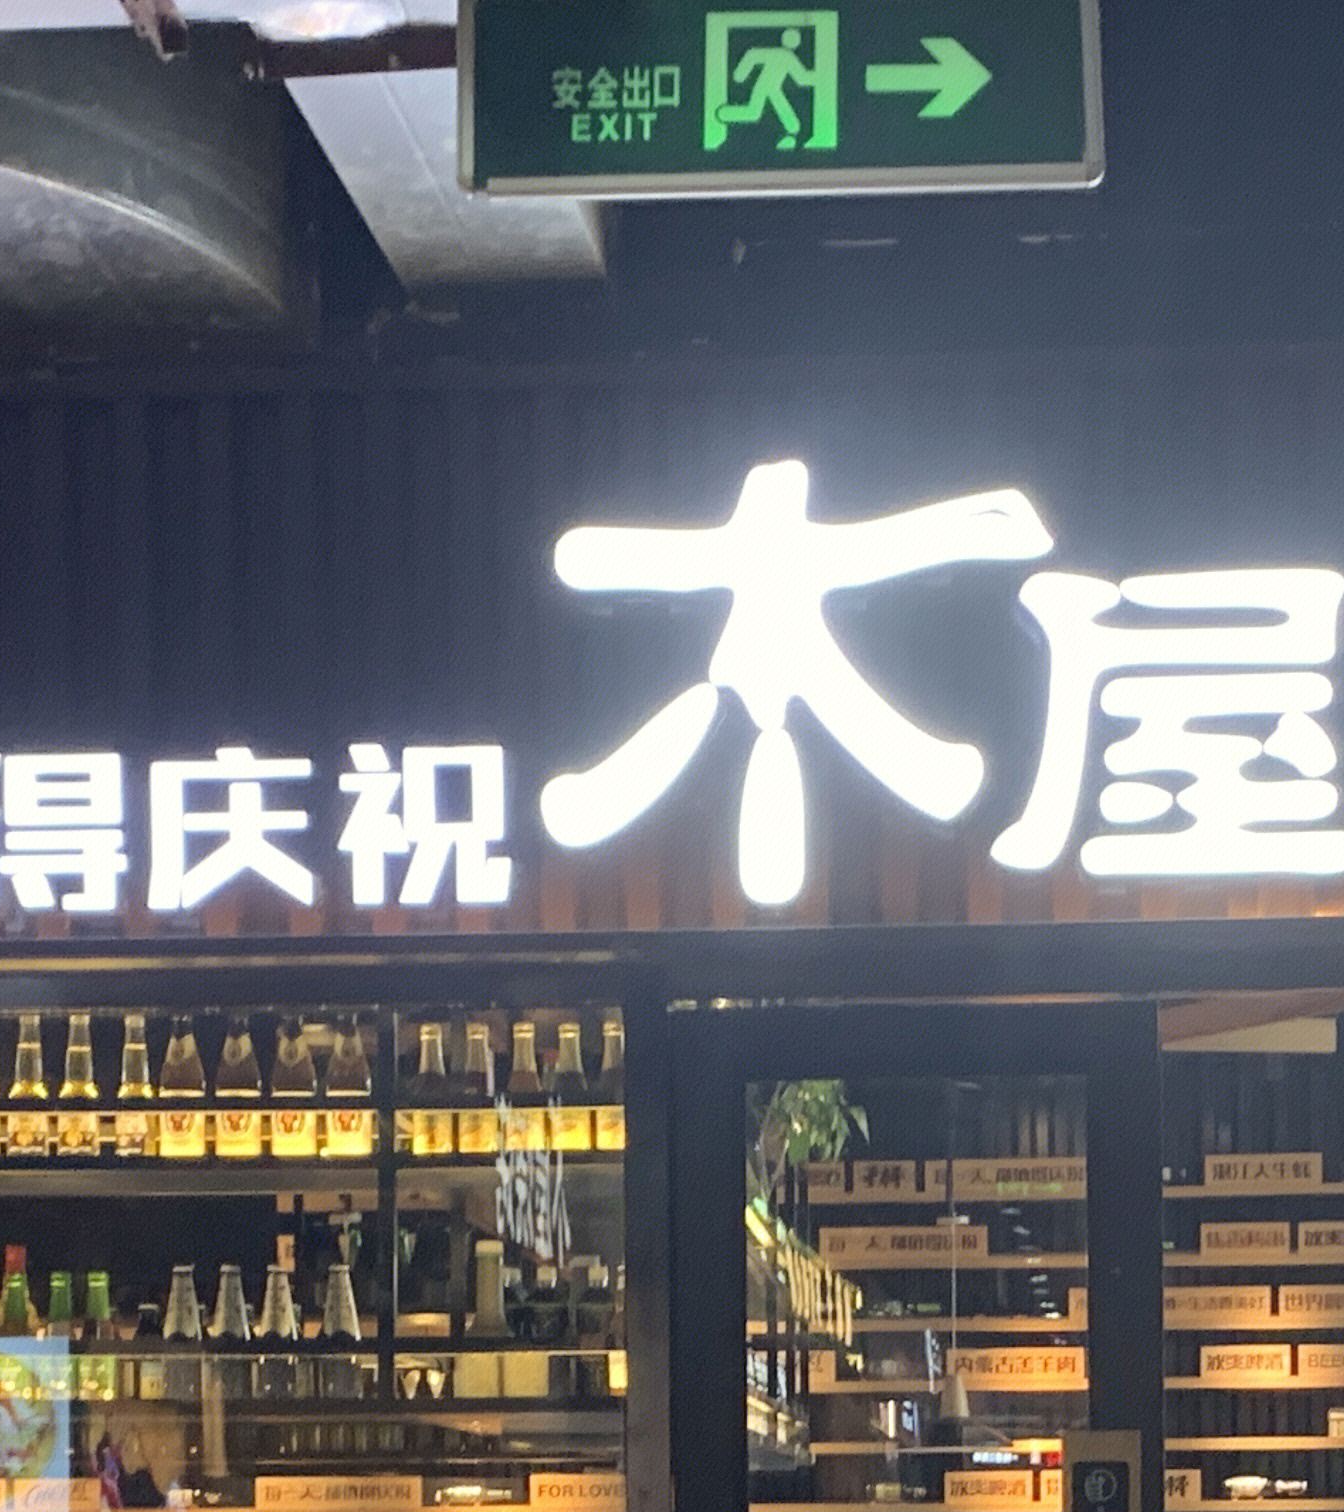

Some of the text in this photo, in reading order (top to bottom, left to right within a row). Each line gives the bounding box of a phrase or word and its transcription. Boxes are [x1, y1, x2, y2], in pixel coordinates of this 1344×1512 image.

[551, 64, 682, 110] 安全出口
[570, 112, 658, 144] EXIT
[536, 1484, 574, 1499] FOR
